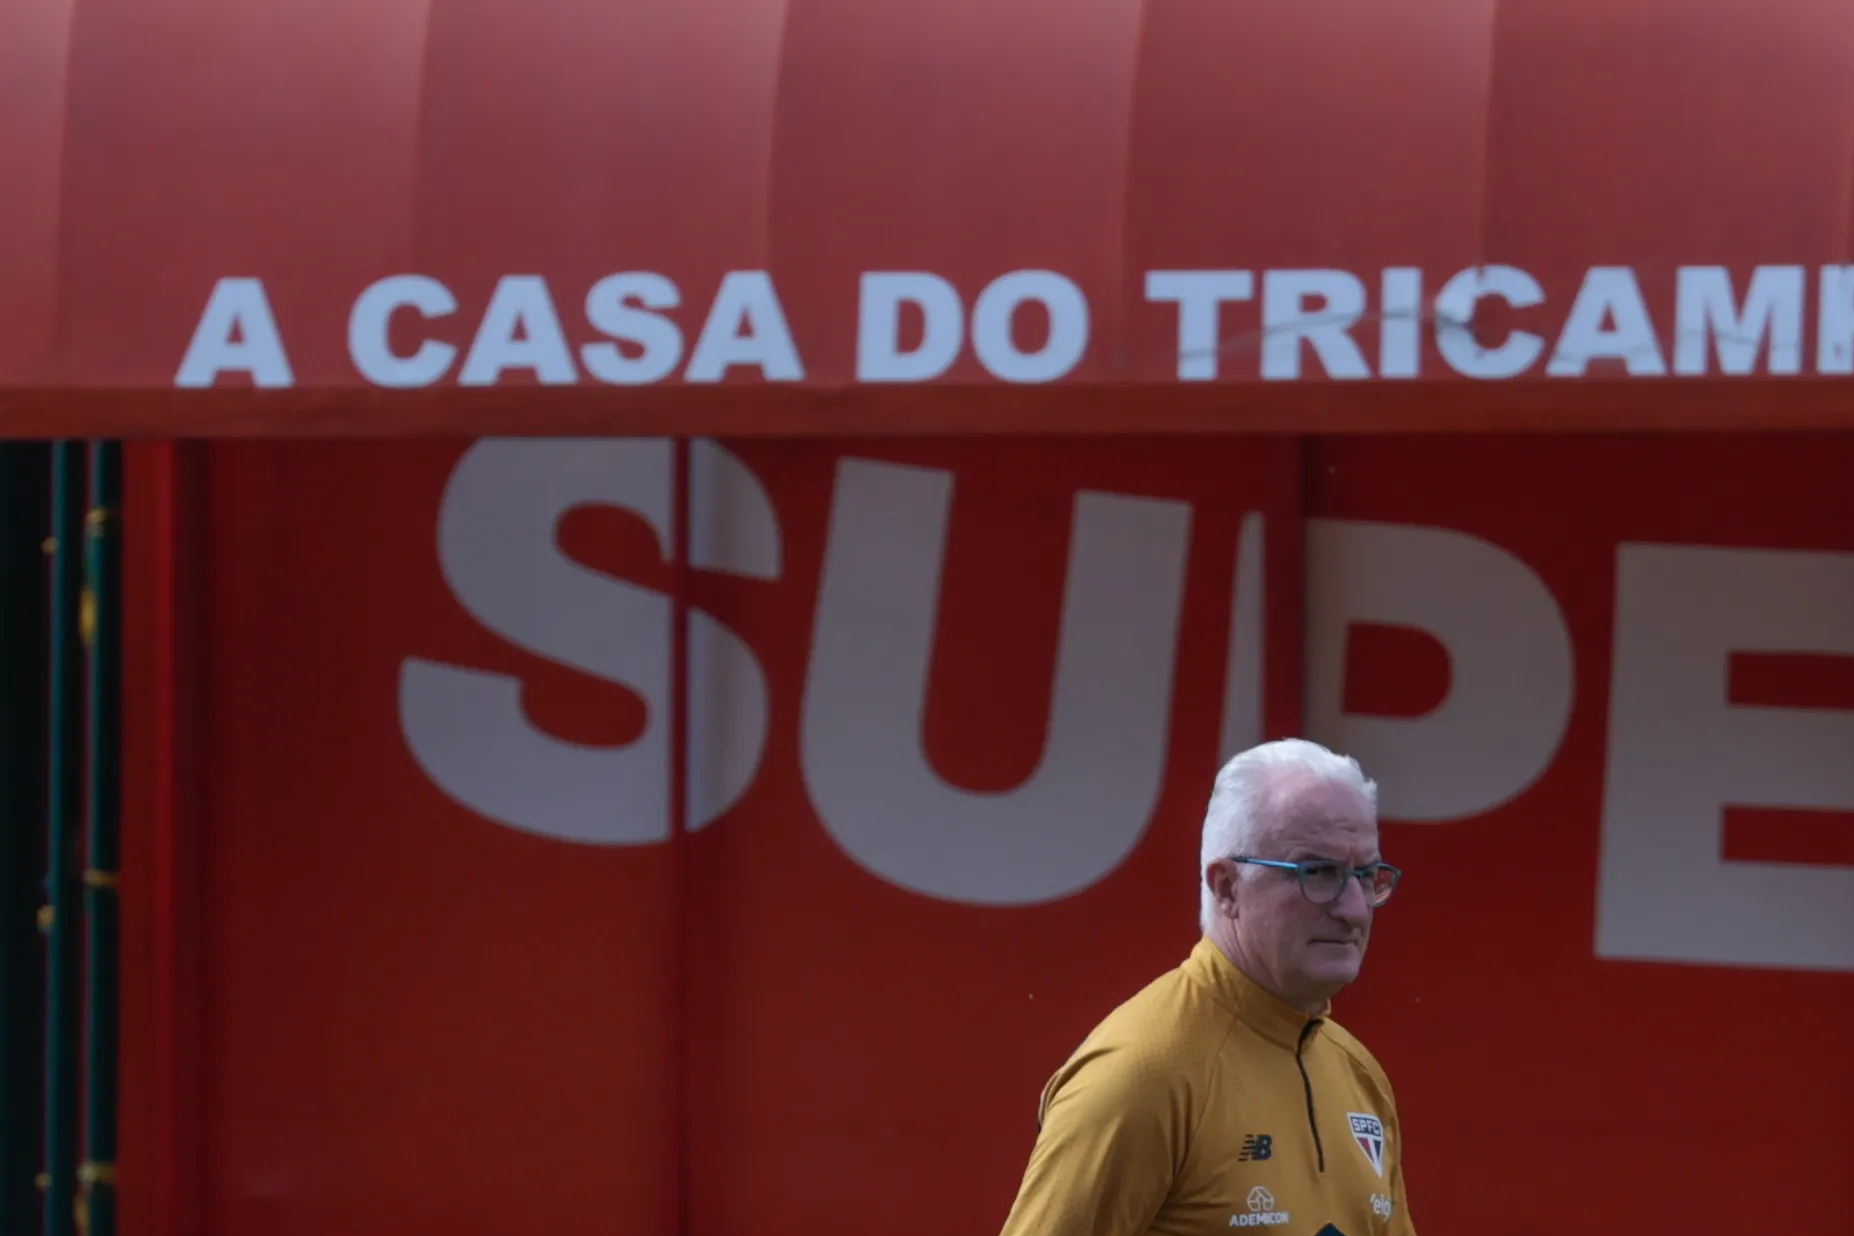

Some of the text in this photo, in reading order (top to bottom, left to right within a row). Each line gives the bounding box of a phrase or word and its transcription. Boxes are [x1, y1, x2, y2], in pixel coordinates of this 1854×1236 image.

[174, 277, 295, 388] A
[347, 270, 805, 389] CASA
[855, 268, 1090, 384] DO
[1351, 1118, 1382, 1135] SPFC
[1229, 1211, 1290, 1227] ADEMICON
